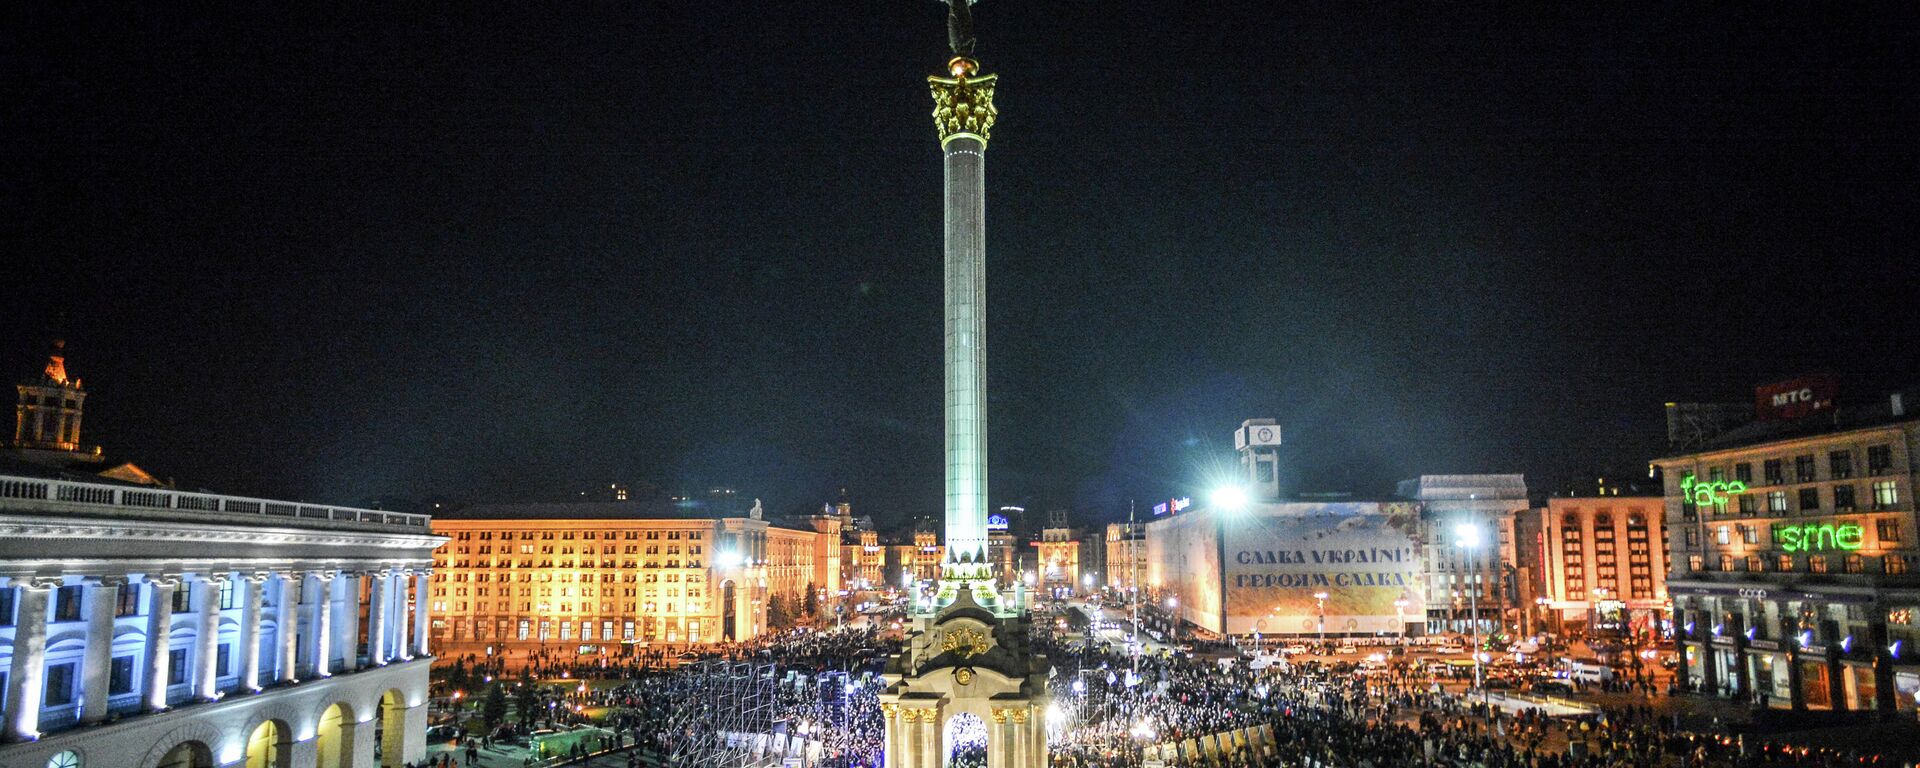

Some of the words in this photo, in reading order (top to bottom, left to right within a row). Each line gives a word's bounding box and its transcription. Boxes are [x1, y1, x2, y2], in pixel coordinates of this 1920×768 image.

[1237, 550, 1306, 565] СЛАВА
[1311, 546, 1412, 564] УКРАЇНІ!
[1236, 573, 1329, 587] ГЕРОЯМ
[1335, 571, 1414, 587] СЛАВА!
